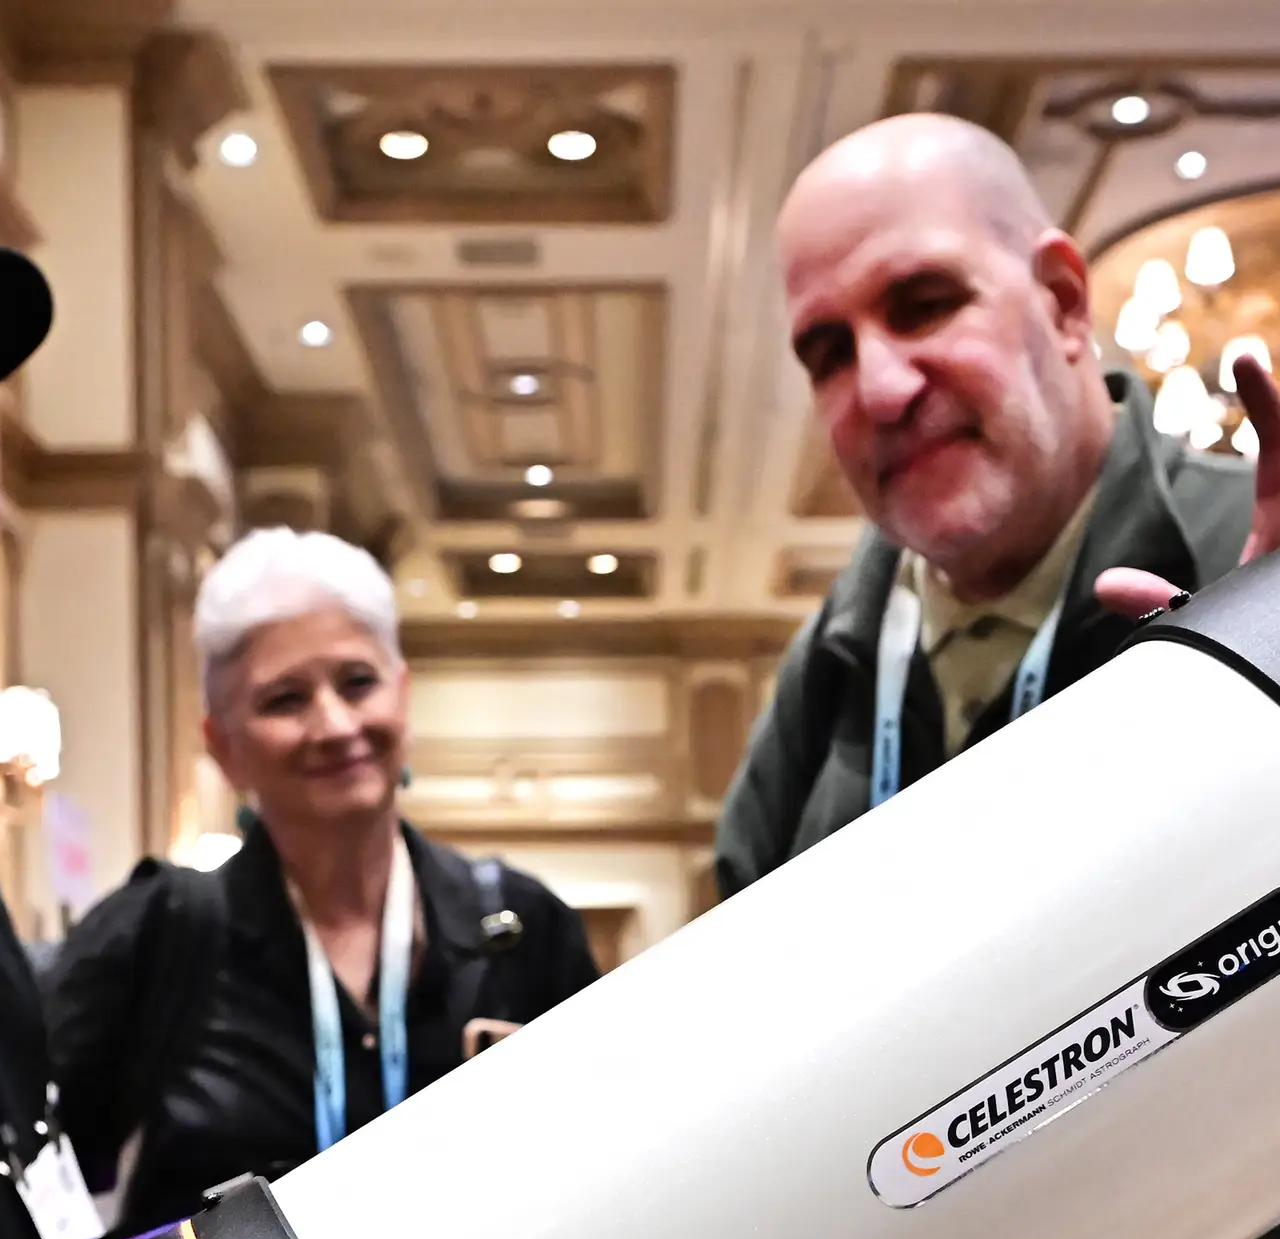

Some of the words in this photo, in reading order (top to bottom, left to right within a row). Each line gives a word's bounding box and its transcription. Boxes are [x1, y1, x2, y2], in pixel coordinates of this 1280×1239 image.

[947, 1007, 1136, 1148] CELESTRON
[1047, 1077, 1087, 1107] SCHMIDT
[1090, 1037, 1151, 1080] ASTROGRAPH
